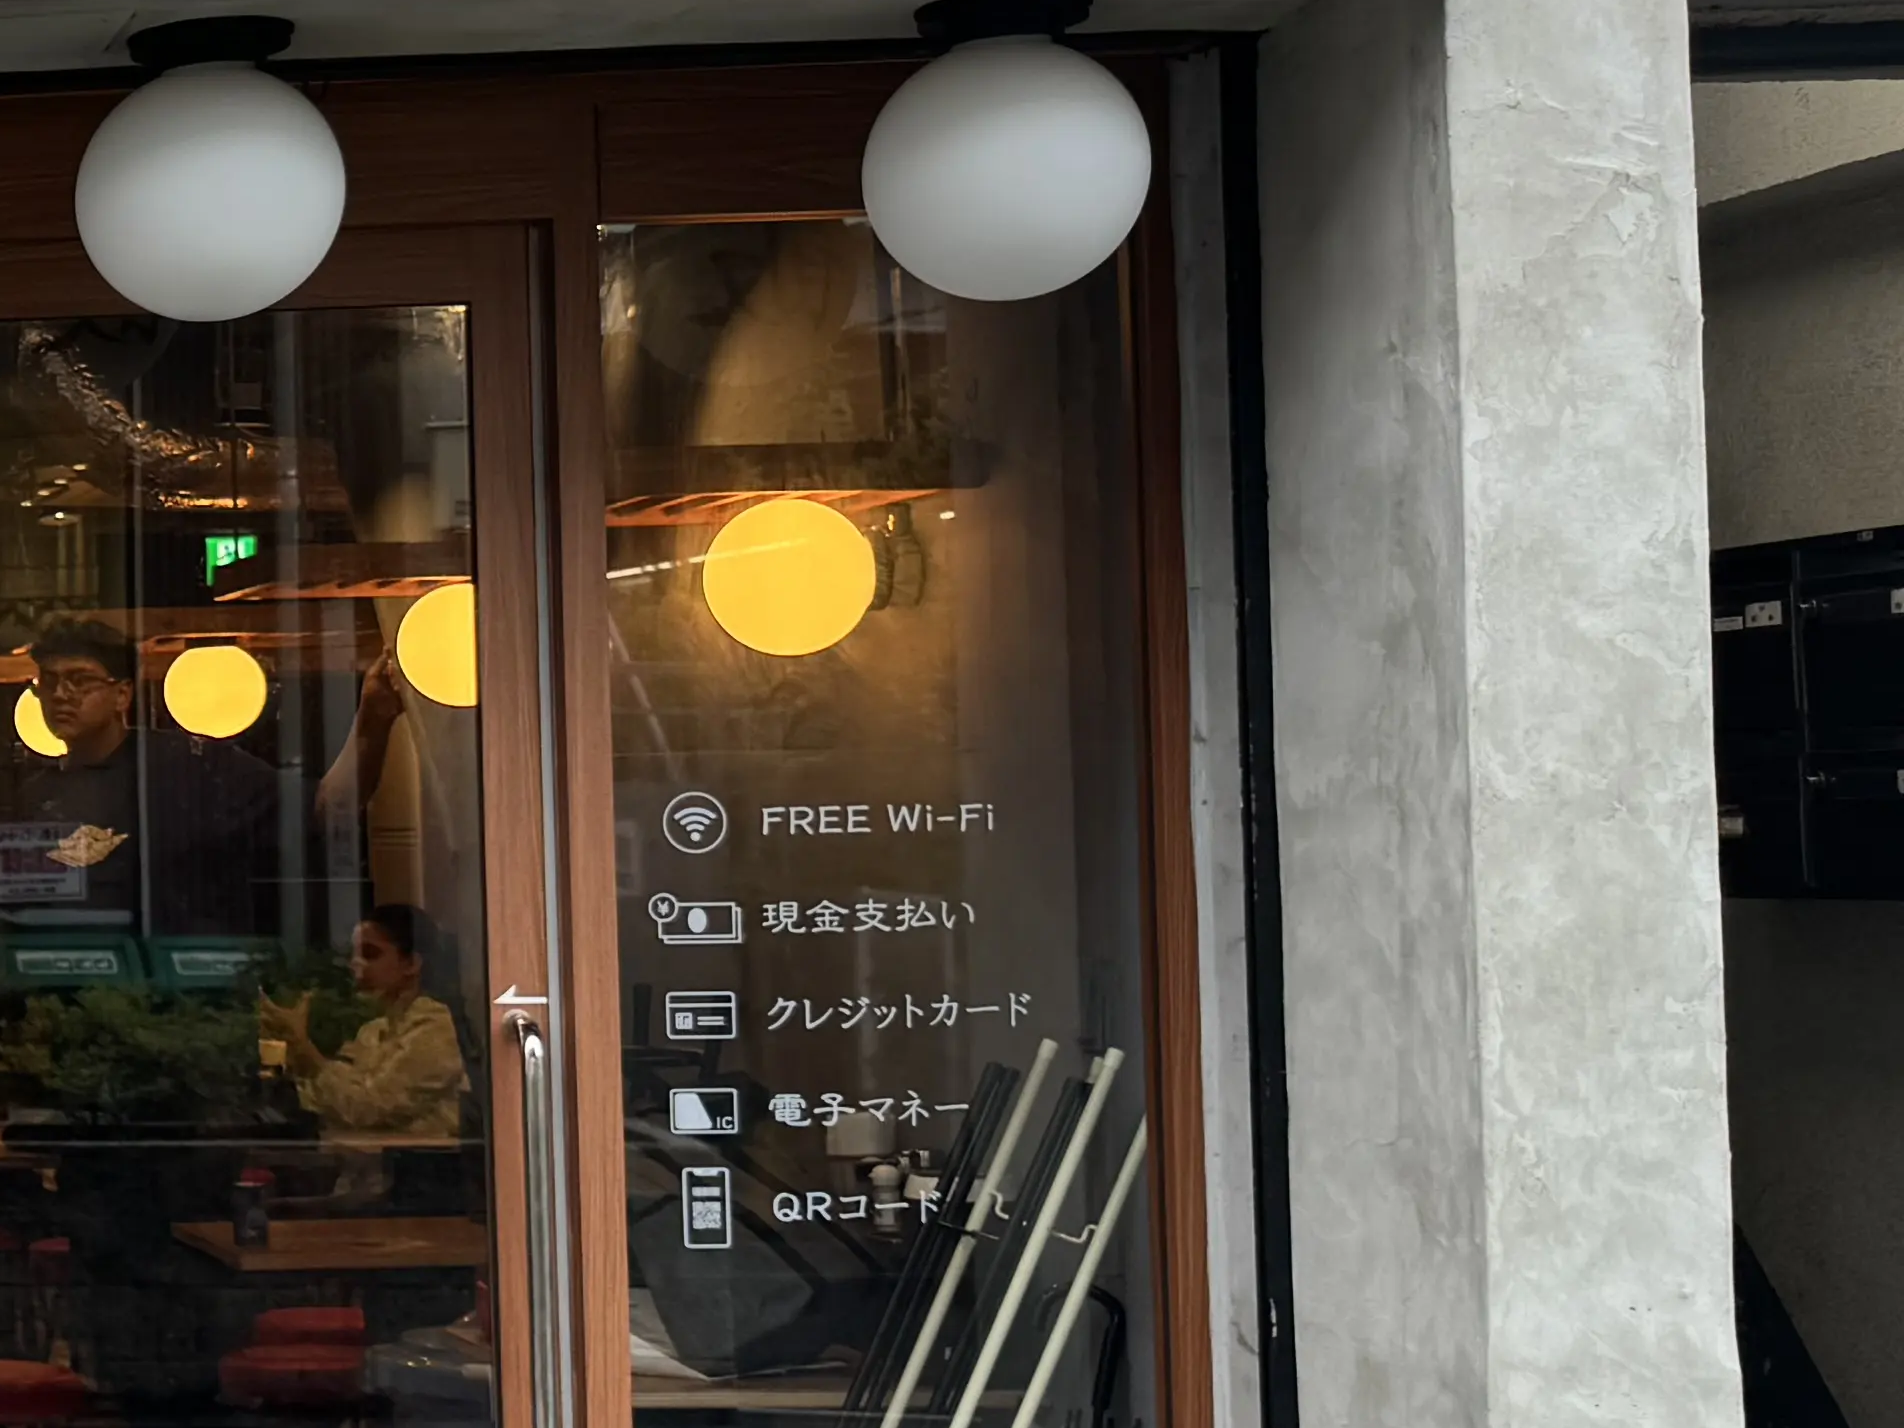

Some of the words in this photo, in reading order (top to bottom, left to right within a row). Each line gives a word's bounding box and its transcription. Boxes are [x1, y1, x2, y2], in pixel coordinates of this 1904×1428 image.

[762, 805, 871, 835] FREE
[887, 803, 994, 833] Wi-Fi
[761, 898, 975, 934] 現金支払い
[766, 992, 1031, 1031] クレジットカード
[767, 1089, 971, 1127] 電子マネー
[772, 1188, 942, 1225] QRコード
